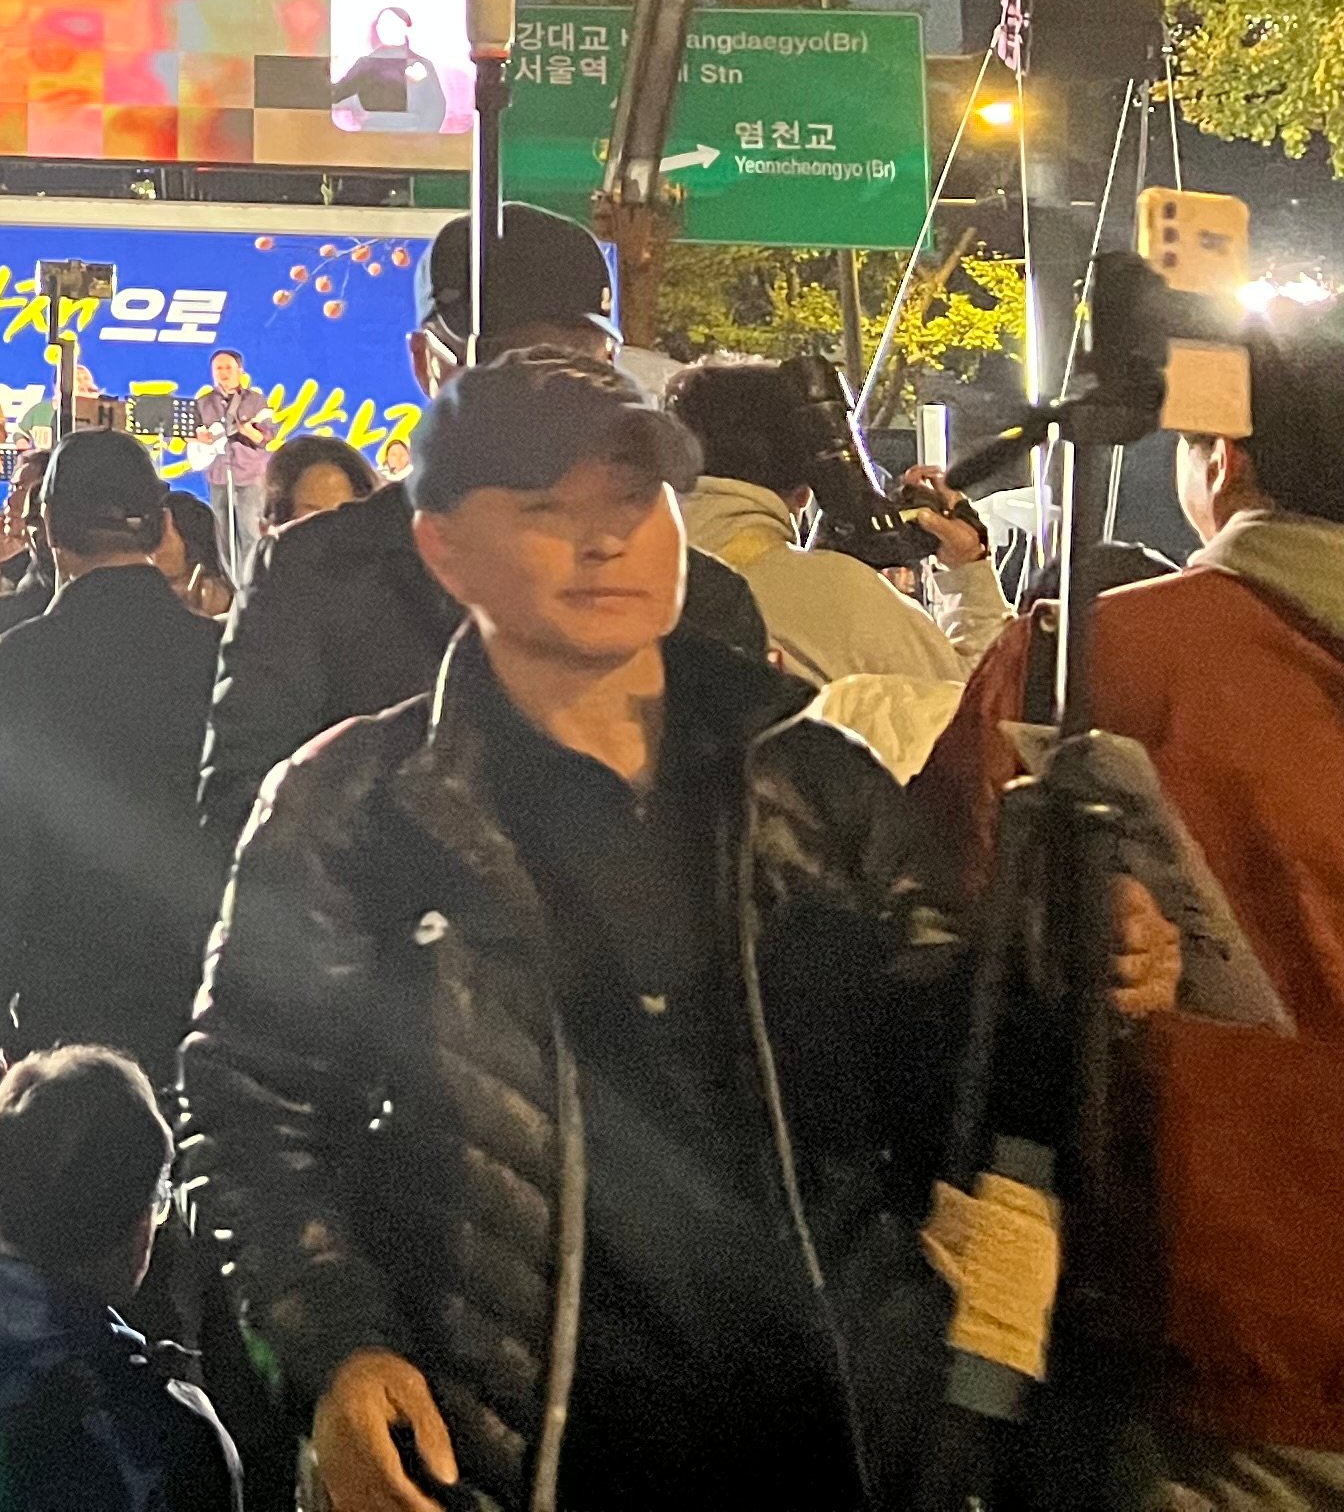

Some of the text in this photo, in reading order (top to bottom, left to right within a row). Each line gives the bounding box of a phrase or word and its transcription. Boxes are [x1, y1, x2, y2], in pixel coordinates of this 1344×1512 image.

[516, 22, 610, 52] 강대교
[514, 54, 607, 85] 서울역
[700, 64, 744, 85] Stn
[734, 119, 837, 151] 염천교
[866, 159, 897, 183] (Br)
